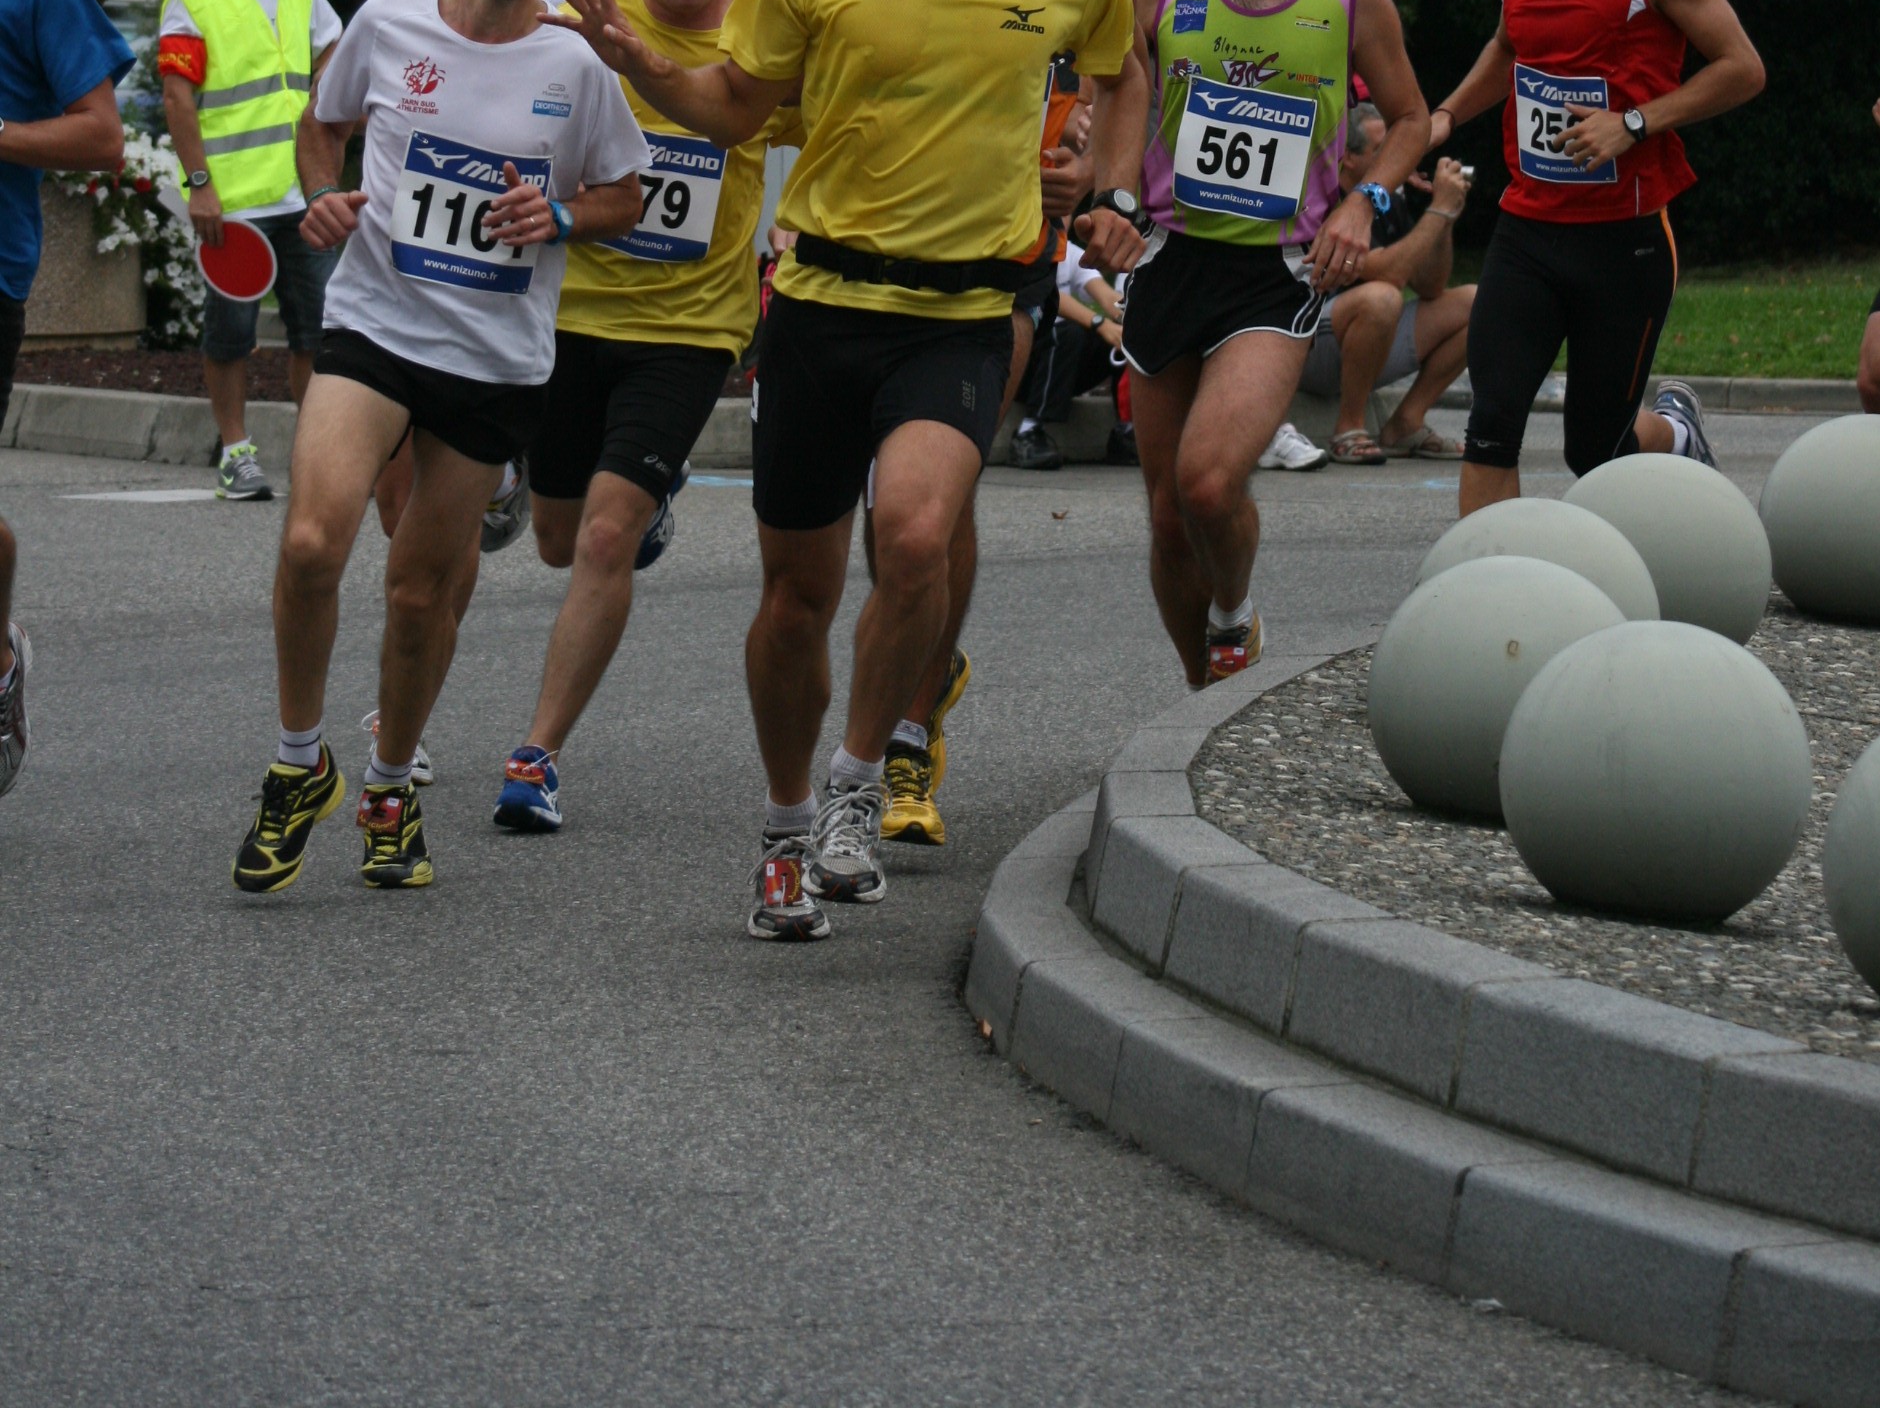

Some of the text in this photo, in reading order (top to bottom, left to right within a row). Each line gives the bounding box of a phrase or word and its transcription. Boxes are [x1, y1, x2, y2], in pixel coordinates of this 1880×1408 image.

[1174, 6, 1209, 16] BLAGNAC
[1213, 36, 1265, 60] Blagnac
[396, 103, 440, 115] ATHLETISME
[401, 97, 436, 108] TARN SUD
[534, 101, 570, 112] DECATHLON
[1196, 125, 1279, 186] 561
[457, 160, 546, 189] MIZNO
[1535, 162, 1586, 173] www.mizuno.fr
[1199, 189, 1264, 208] www.mizuno.fr
[424, 258, 498, 281] www.mizuno.fr
